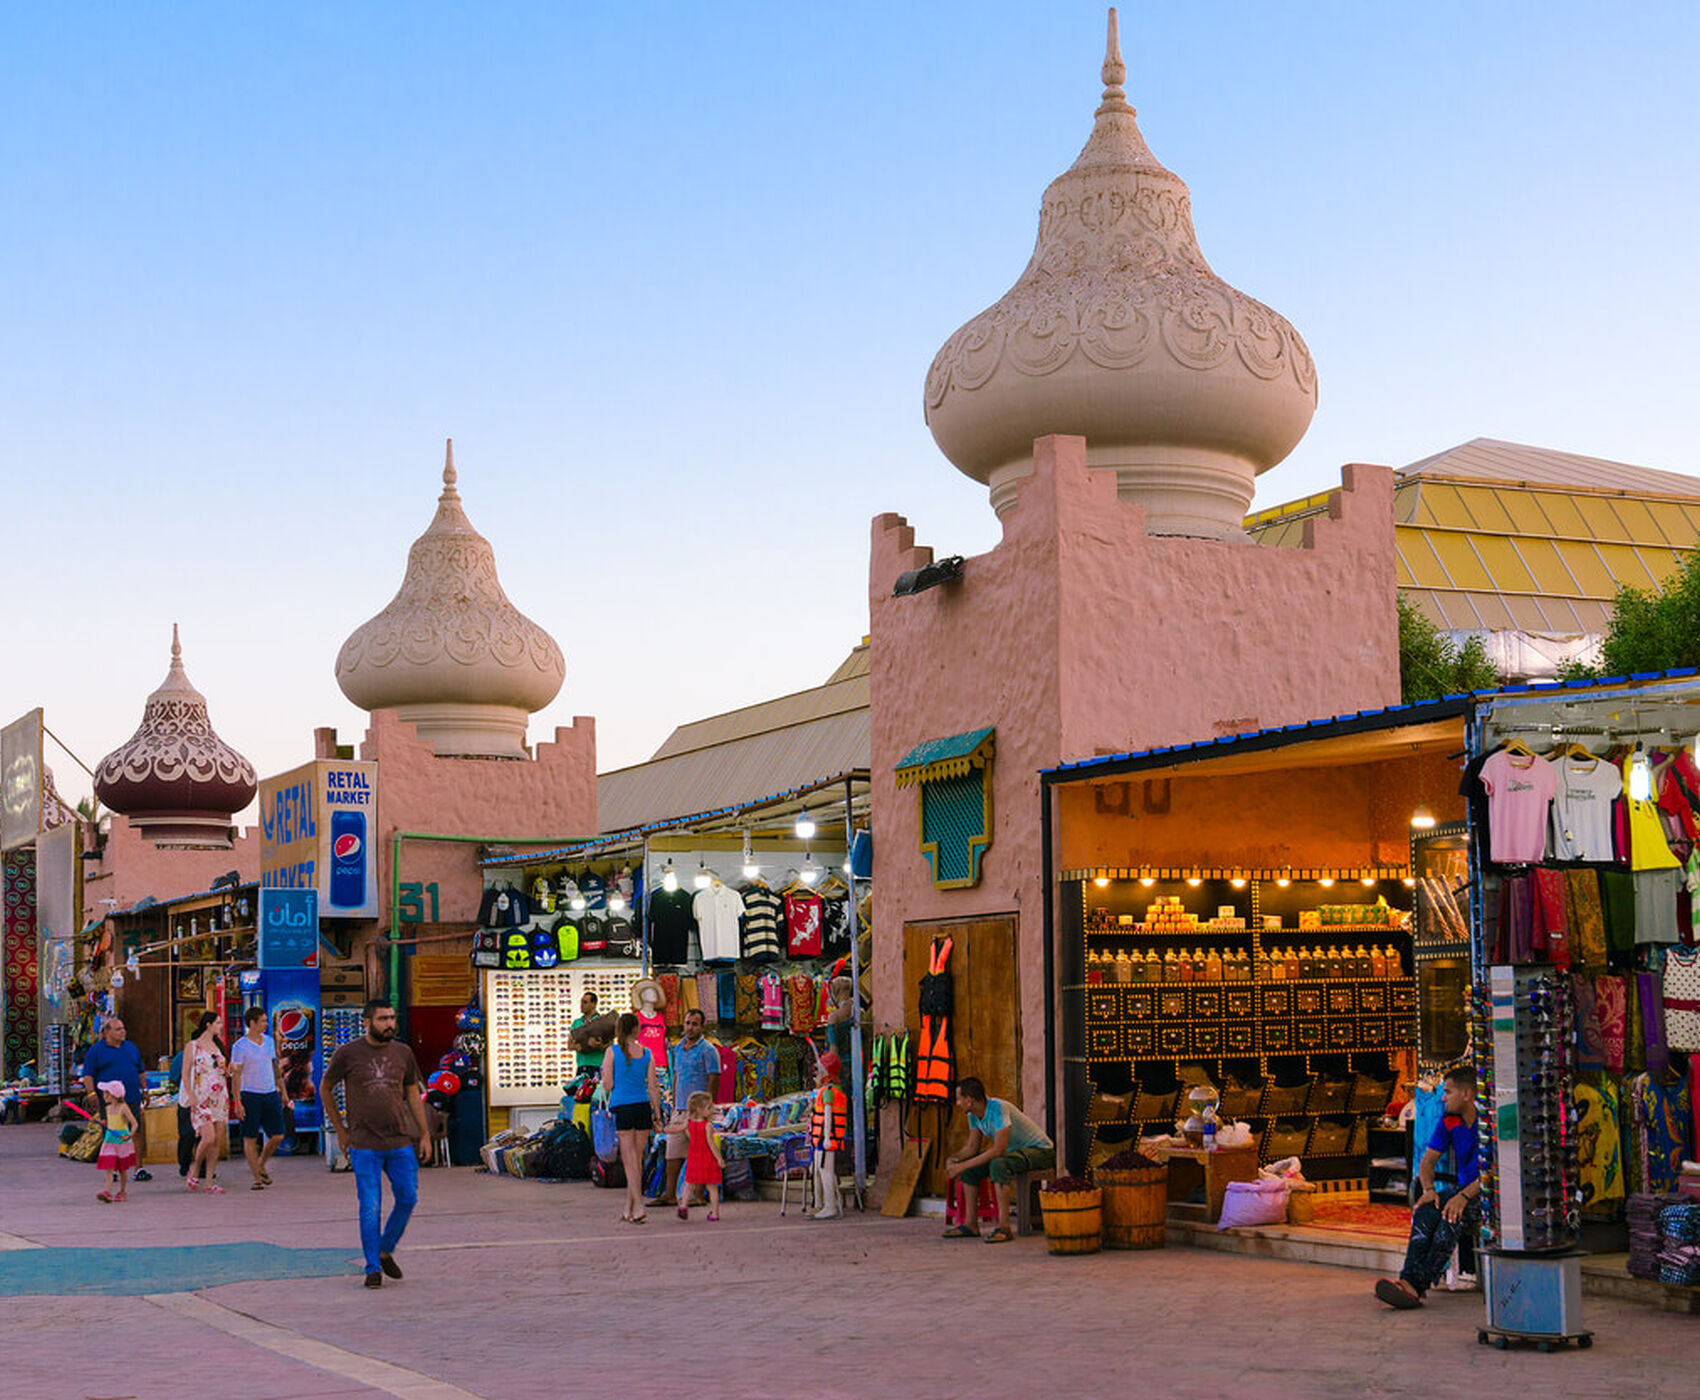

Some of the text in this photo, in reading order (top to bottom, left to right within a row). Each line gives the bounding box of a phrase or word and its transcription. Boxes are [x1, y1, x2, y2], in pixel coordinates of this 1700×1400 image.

[328, 771, 370, 788] RETAL
[326, 790, 371, 805] MARKET
[276, 781, 316, 845] RETAL
[268, 895, 314, 927] أمان
[399, 882, 439, 923] 31
[281, 1039, 308, 1051] pepsi
